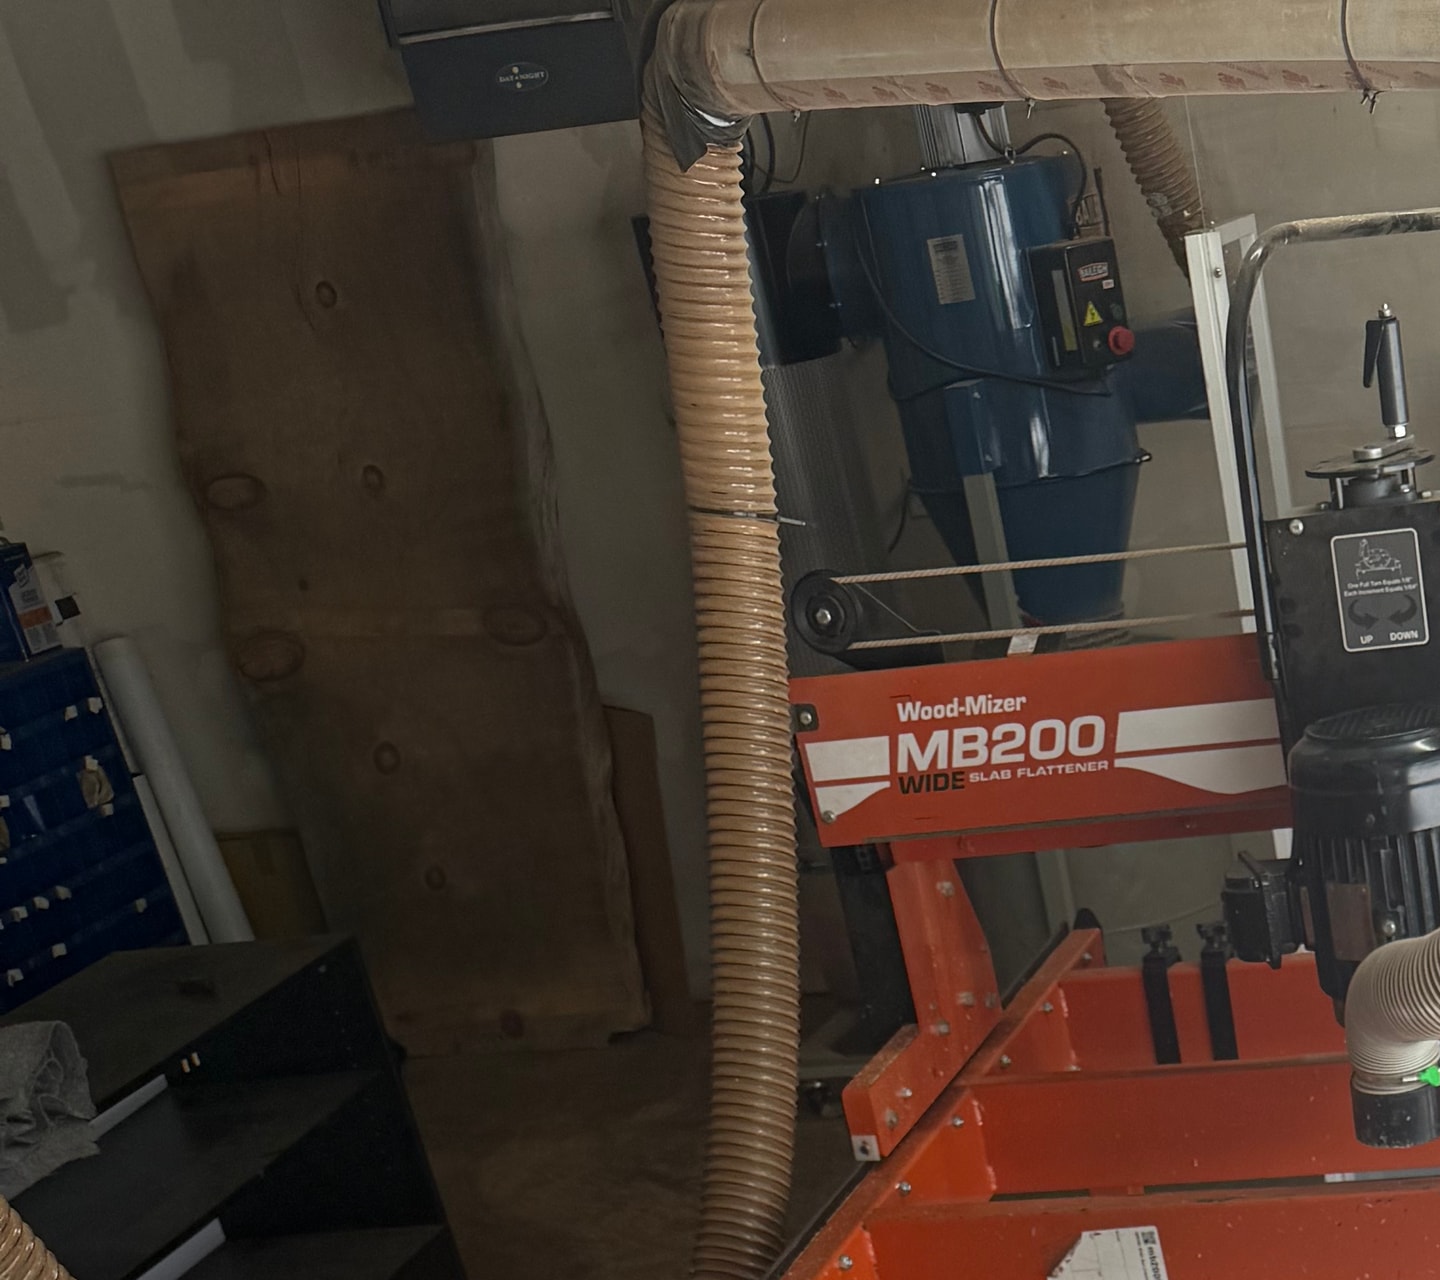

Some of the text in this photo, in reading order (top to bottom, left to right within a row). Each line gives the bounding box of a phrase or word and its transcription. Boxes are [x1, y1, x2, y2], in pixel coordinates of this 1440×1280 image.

[1360, 630, 1419, 644] UP DOWN
[896, 694, 1028, 723] Wood-Mizer
[896, 715, 1106, 774] MB200
[898, 760, 1109, 795] WIDE SLAB FLATTENER
